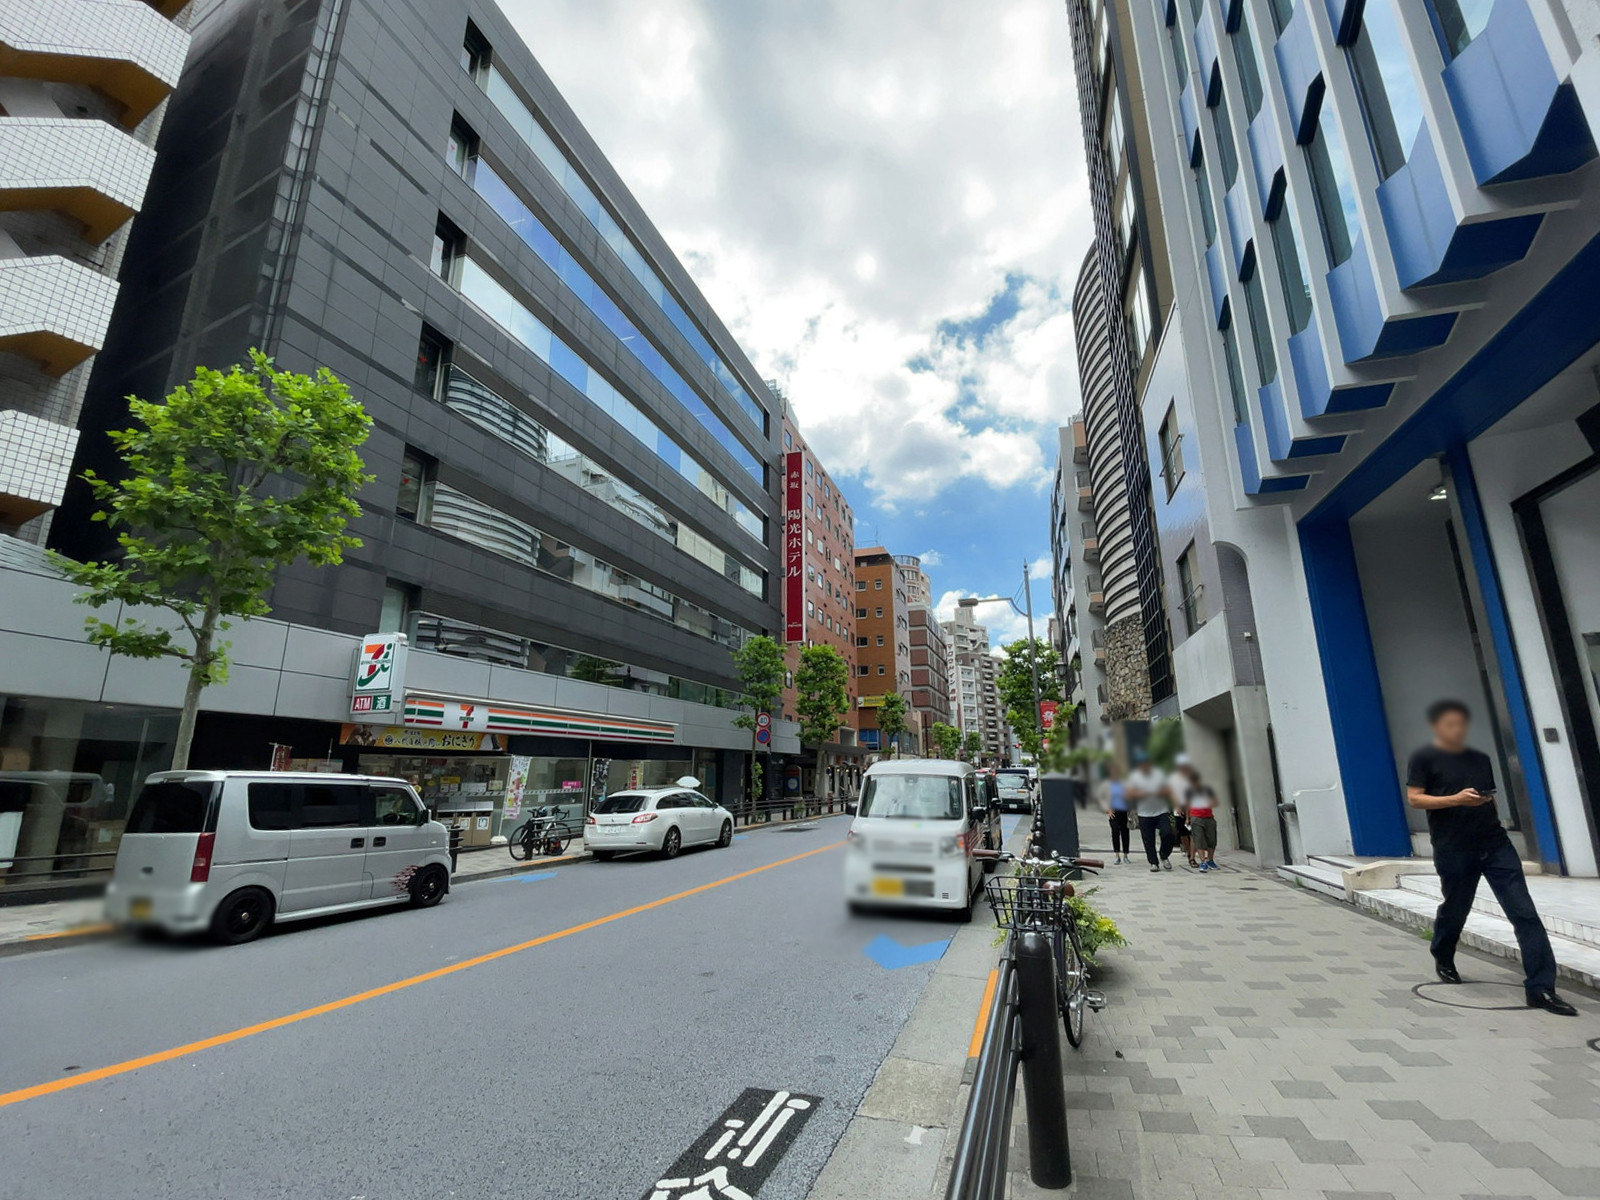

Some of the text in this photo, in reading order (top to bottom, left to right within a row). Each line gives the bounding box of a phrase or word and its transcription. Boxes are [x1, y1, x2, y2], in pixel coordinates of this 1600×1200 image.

[787, 509, 801, 578] 陽光ホテル
[354, 697, 371, 710] ATM
[376, 696, 387, 710] 酒
[759, 716, 767, 724] 40
[442, 734, 475, 748] おにぎり
